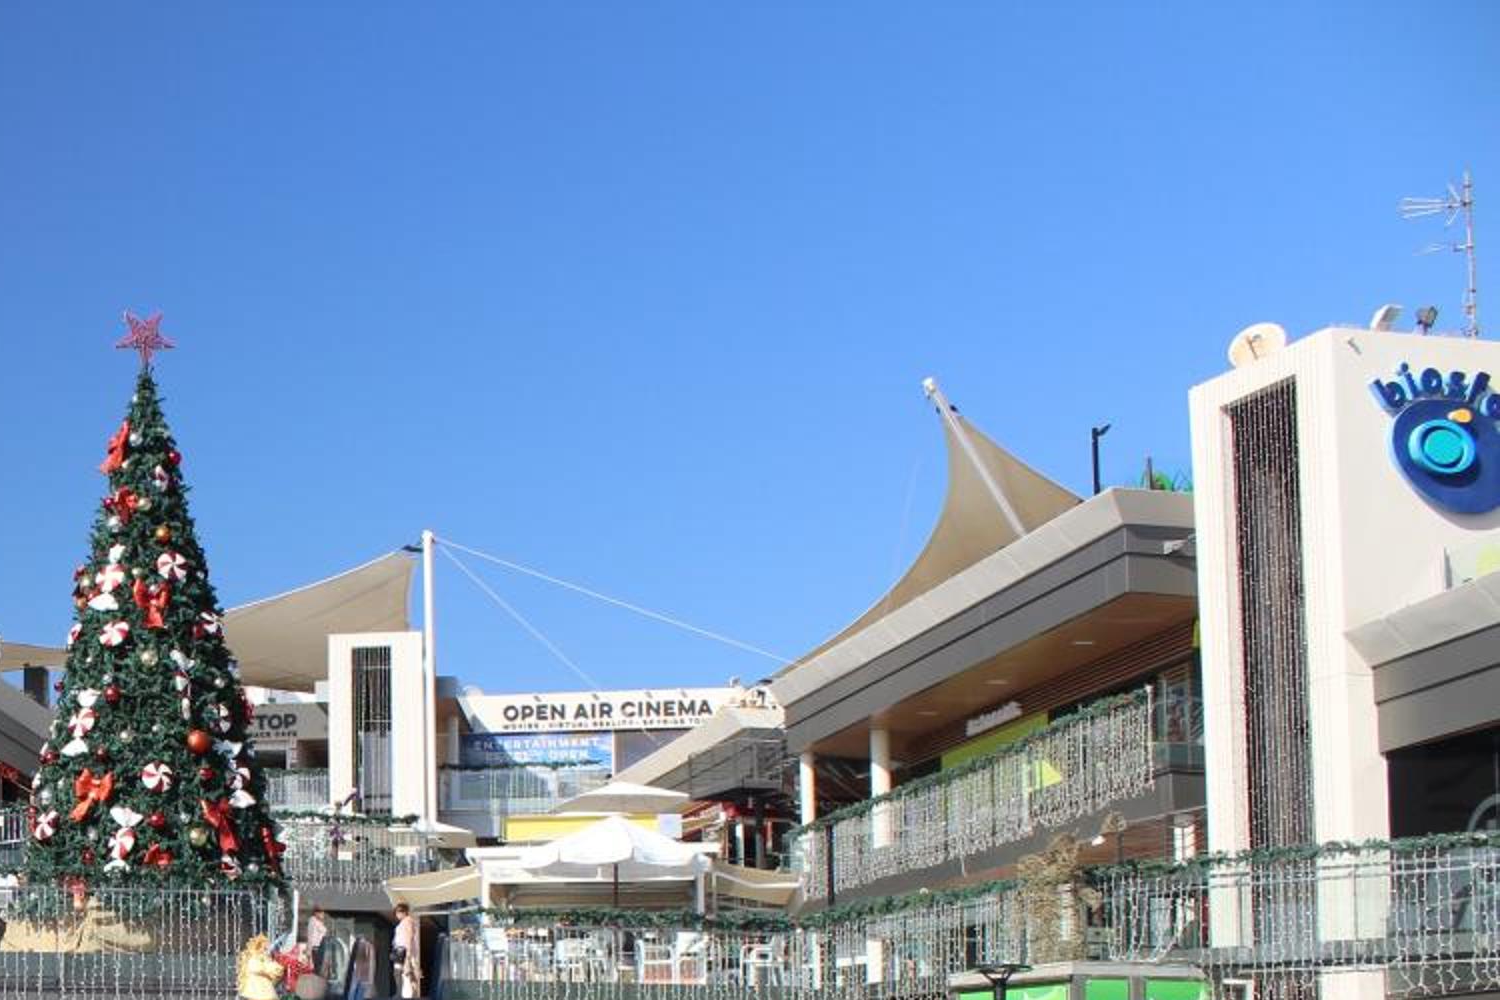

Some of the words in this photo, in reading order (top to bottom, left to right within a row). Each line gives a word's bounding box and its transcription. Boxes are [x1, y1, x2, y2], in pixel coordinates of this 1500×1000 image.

[503, 705, 566, 721] OPEN
[574, 703, 613, 719] AIR
[621, 700, 713, 717] CINEMA
